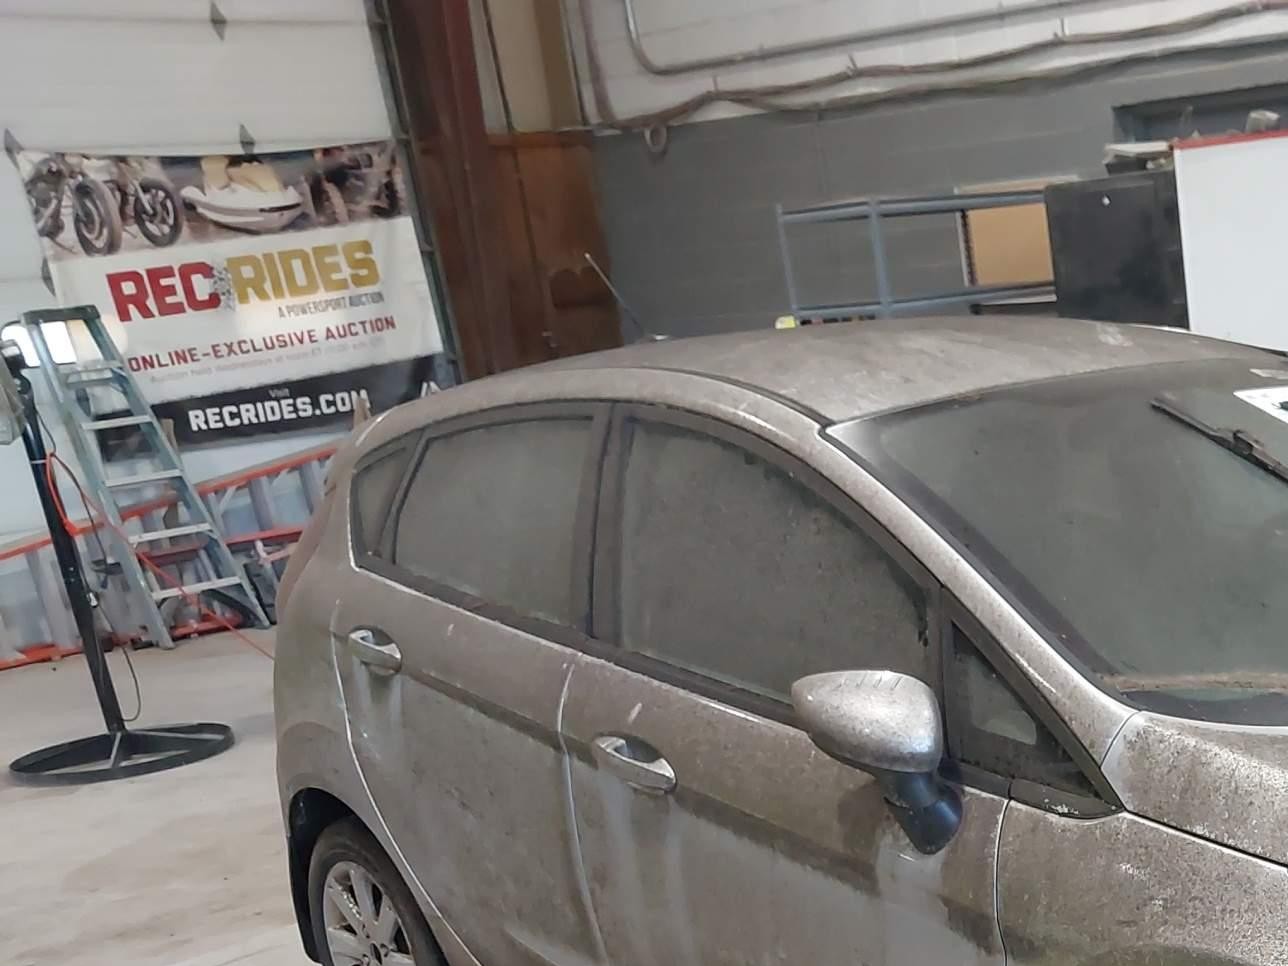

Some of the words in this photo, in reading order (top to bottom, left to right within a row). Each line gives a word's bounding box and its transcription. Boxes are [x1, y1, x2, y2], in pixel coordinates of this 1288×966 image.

[106, 261, 221, 322] REC
[226, 239, 381, 304] RIDES
[127, 329, 319, 373] ONLINE-EXCLUSIVE
[325, 315, 397, 341] AUCTION
[188, 388, 371, 432] RECRIDES.COM
